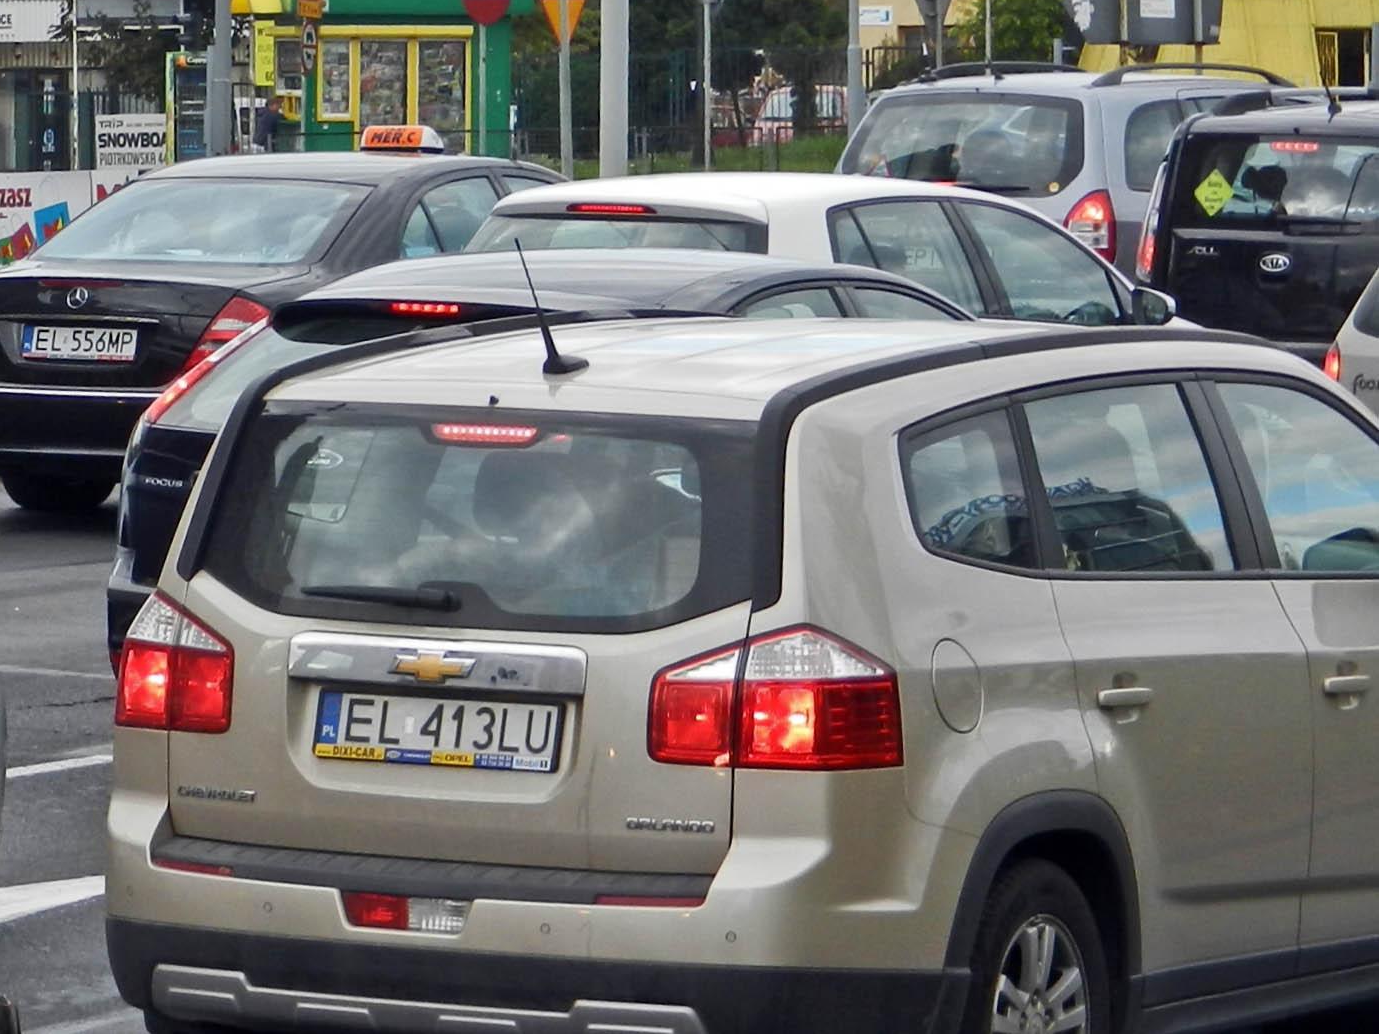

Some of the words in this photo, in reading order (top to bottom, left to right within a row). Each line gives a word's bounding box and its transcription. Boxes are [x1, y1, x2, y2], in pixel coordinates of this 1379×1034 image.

[99, 151, 156, 166] PIOTRKOWSKA
[1262, 255, 1287, 270] KIA
[36, 329, 61, 351] EL
[71, 329, 133, 353] 556MP
[145, 477, 183, 487] FOCUS
[321, 725, 335, 738] PL
[345, 698, 400, 744] EL
[420, 703, 552, 754] 413LU
[333, 746, 376, 758] DIXI-CAR
[445, 753, 470, 763] OPEL
[177, 785, 258, 802] CHEVROLET
[626, 817, 715, 834] ORLANDO
